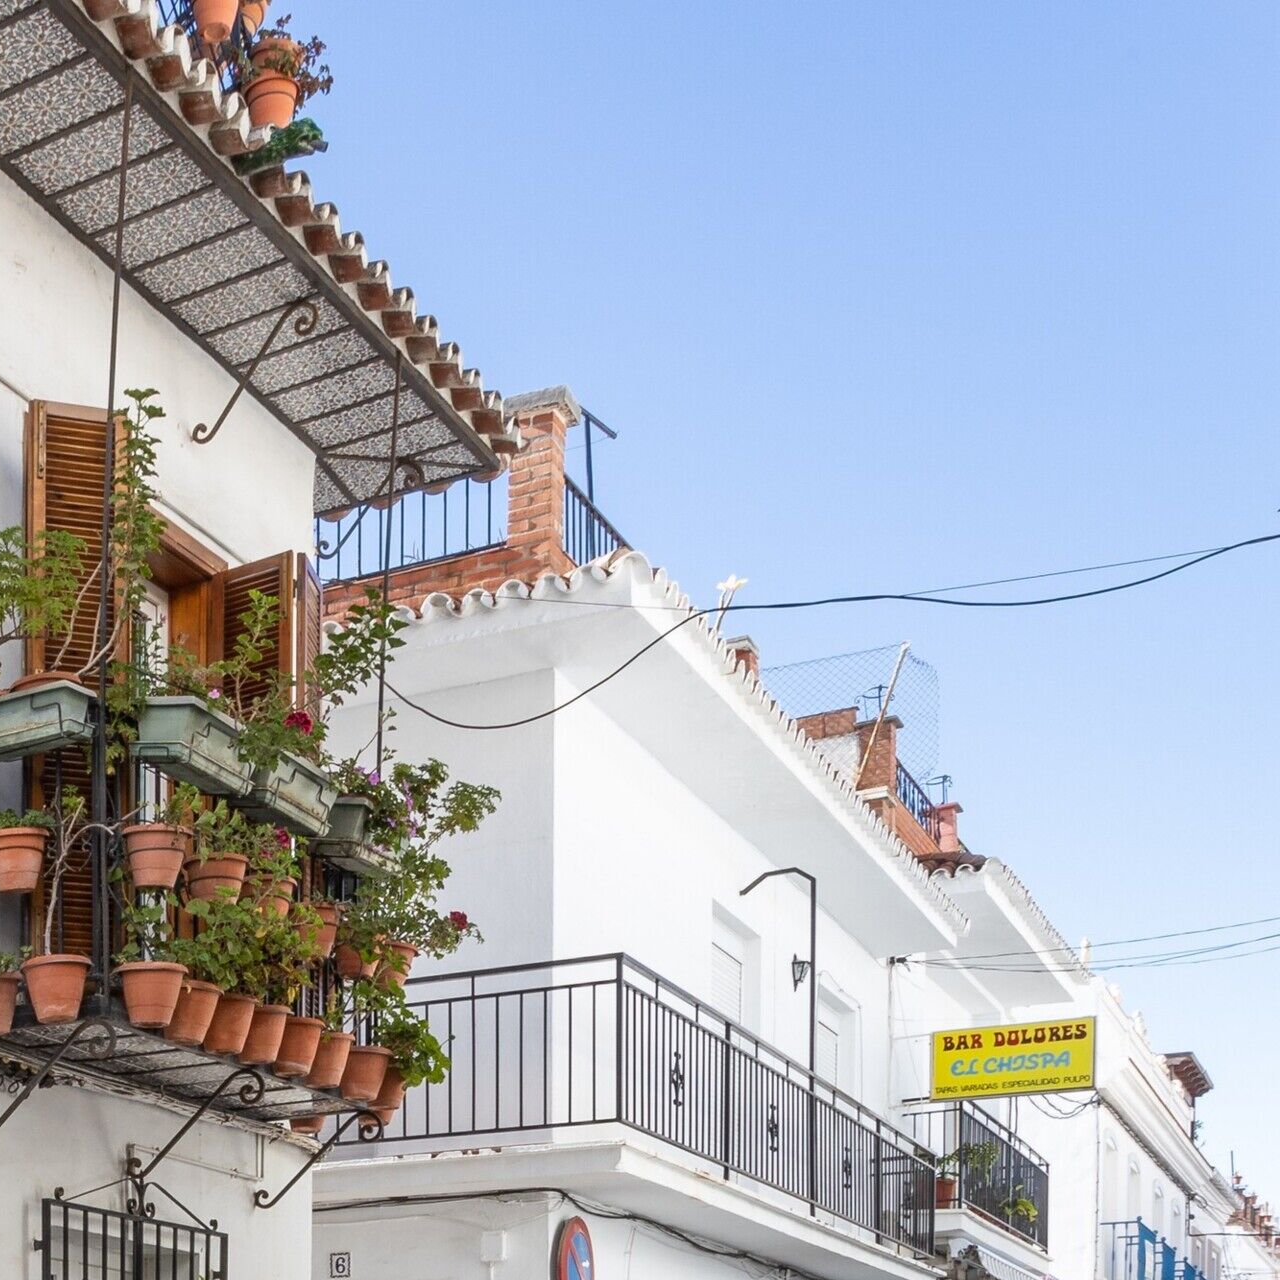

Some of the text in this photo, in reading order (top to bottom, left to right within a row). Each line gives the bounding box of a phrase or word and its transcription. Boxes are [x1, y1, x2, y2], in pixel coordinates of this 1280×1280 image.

[943, 1024, 1087, 1051] BAR DOLORES
[950, 1051, 1070, 1076] EL CHISPA
[935, 1074, 1090, 1094] TAPAS VARIADAS ESPECIALIDAD PULPO
[335, 1256, 346, 1274] 6
